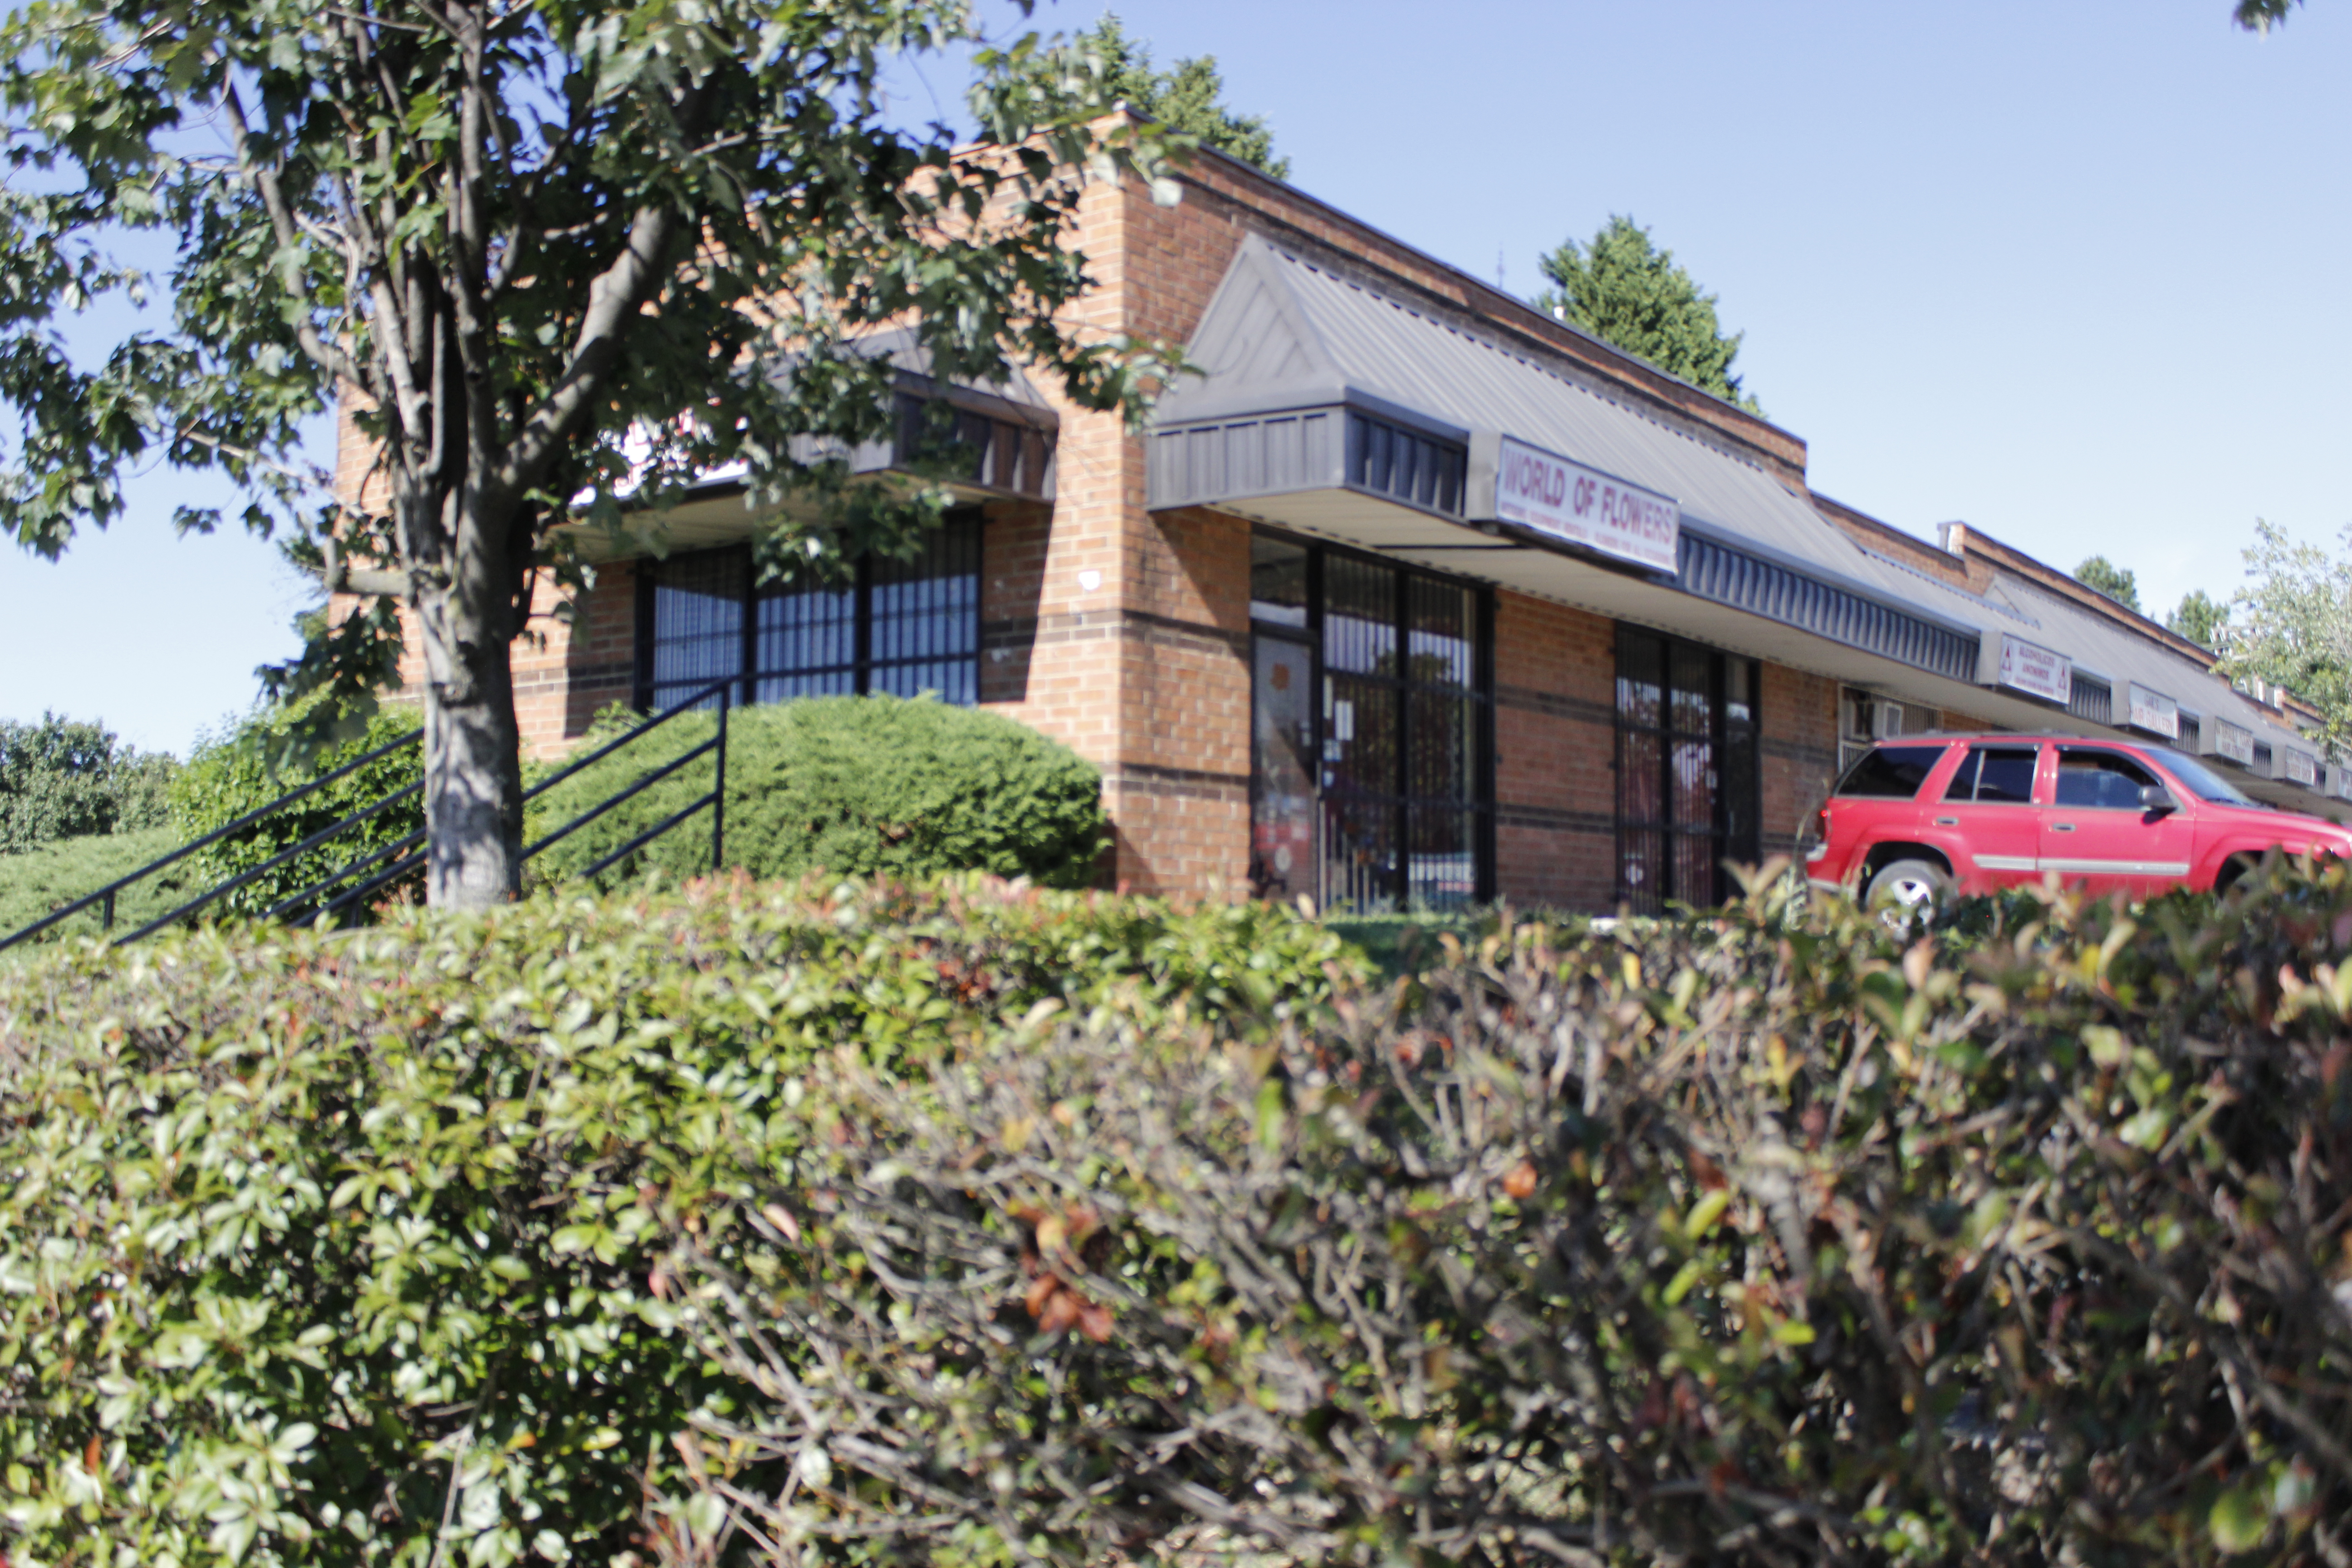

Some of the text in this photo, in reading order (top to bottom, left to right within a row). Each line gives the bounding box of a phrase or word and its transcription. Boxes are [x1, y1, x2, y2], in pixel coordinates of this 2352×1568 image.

[1504, 447, 1564, 508] WORLD
[1574, 475, 1597, 519] OF
[1601, 485, 1671, 544] FLOWERS
